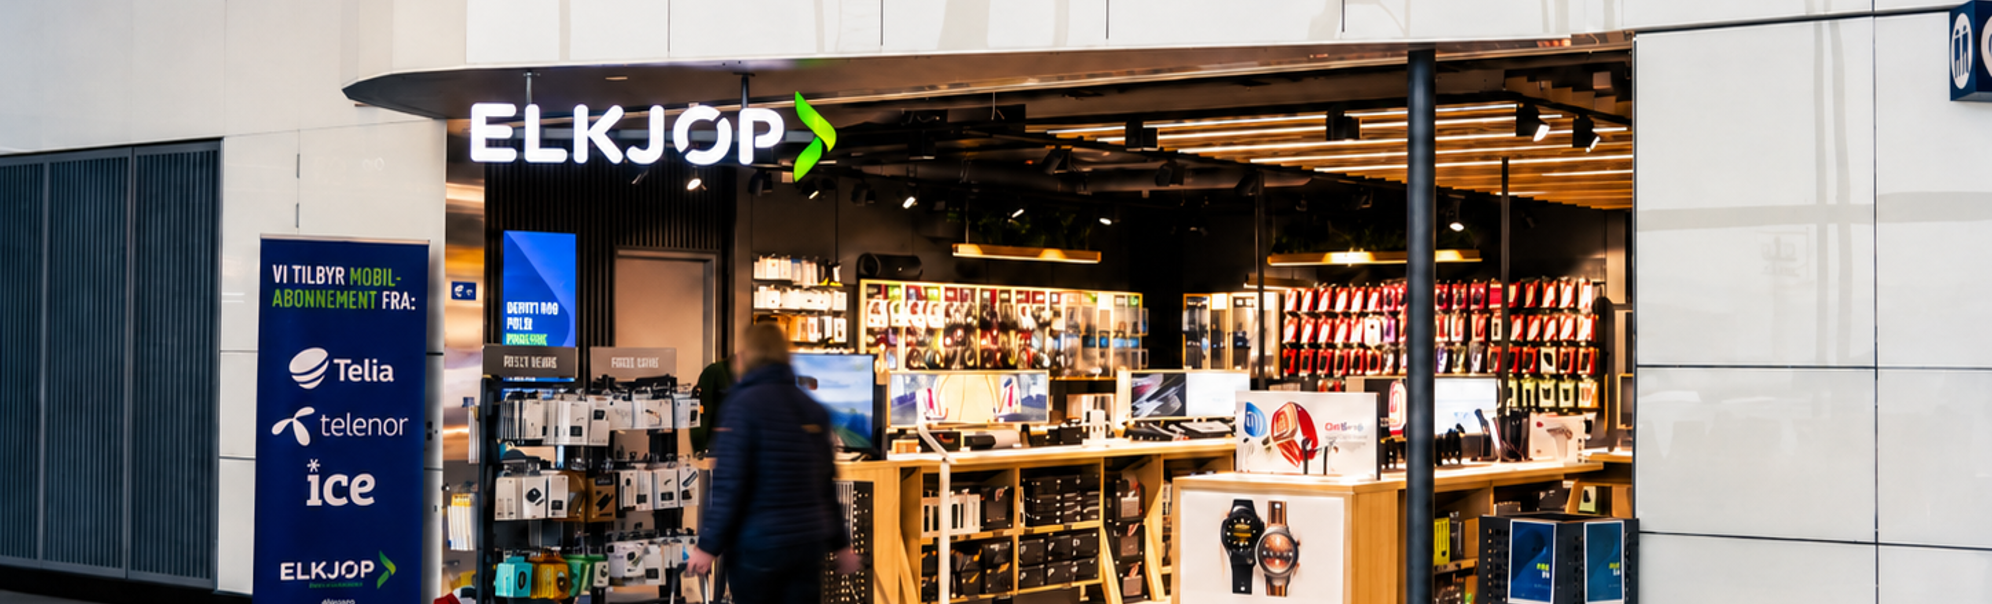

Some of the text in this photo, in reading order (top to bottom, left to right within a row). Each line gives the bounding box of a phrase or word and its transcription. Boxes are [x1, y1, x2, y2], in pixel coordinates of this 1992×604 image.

[272, 265, 402, 287] VI TILBYR MOBIL-
[272, 289, 416, 310] ABONNEMENT FRA:
[333, 358, 395, 382] Telia
[320, 412, 409, 436] telenor
[306, 459, 376, 506] ice
